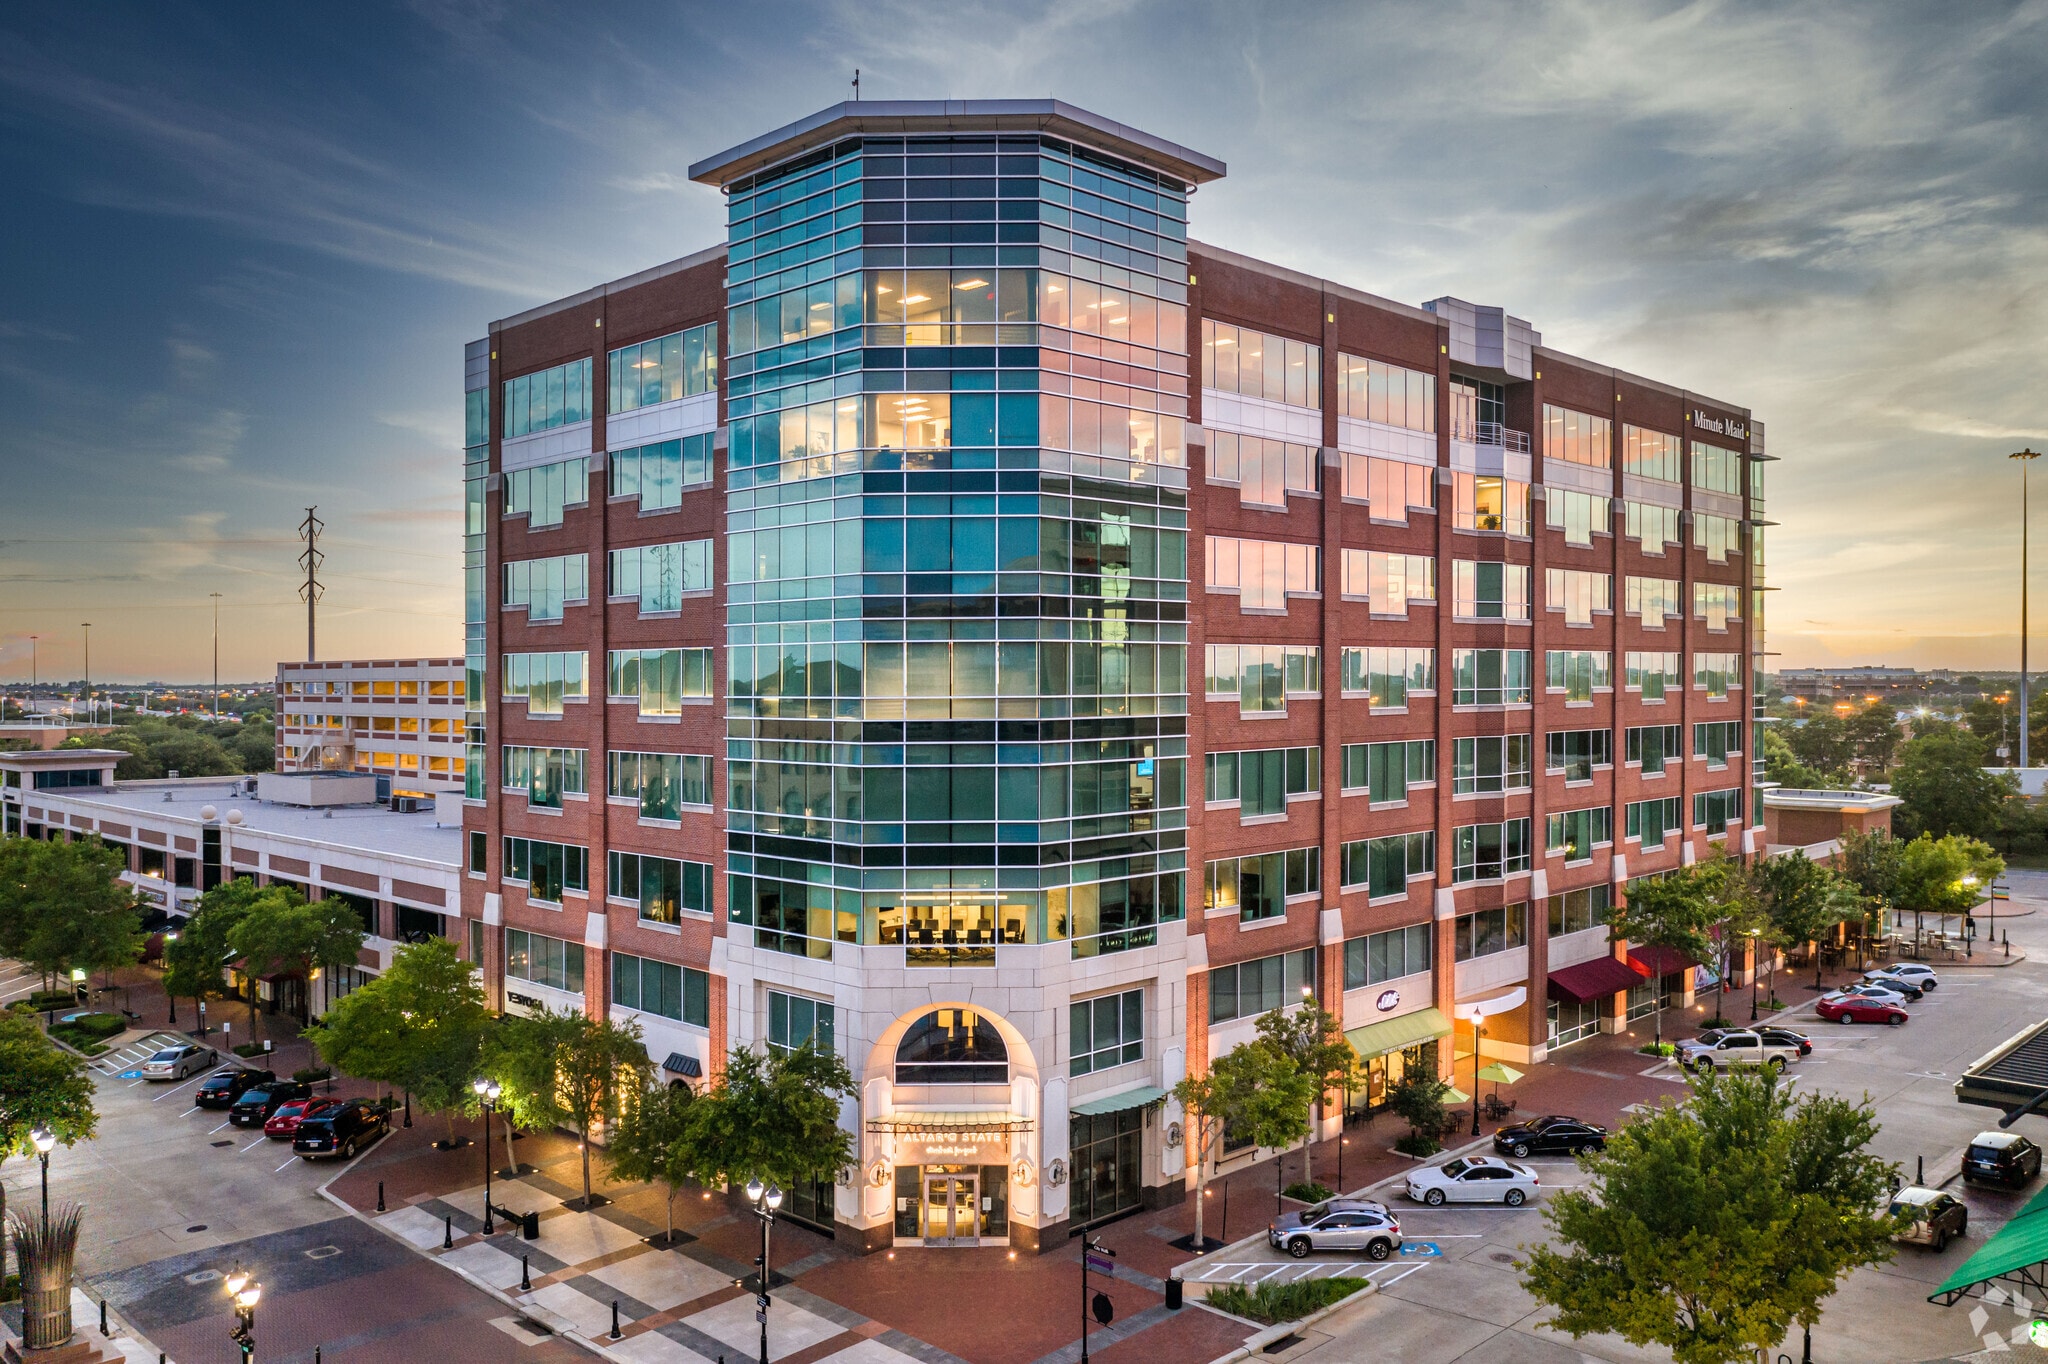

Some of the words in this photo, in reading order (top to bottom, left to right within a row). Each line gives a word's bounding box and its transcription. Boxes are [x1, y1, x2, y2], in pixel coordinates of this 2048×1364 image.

[1693, 409, 1724, 434] Minute
[1724, 418, 1745, 440] Maid
[961, 1132, 1001, 1143] STATE
